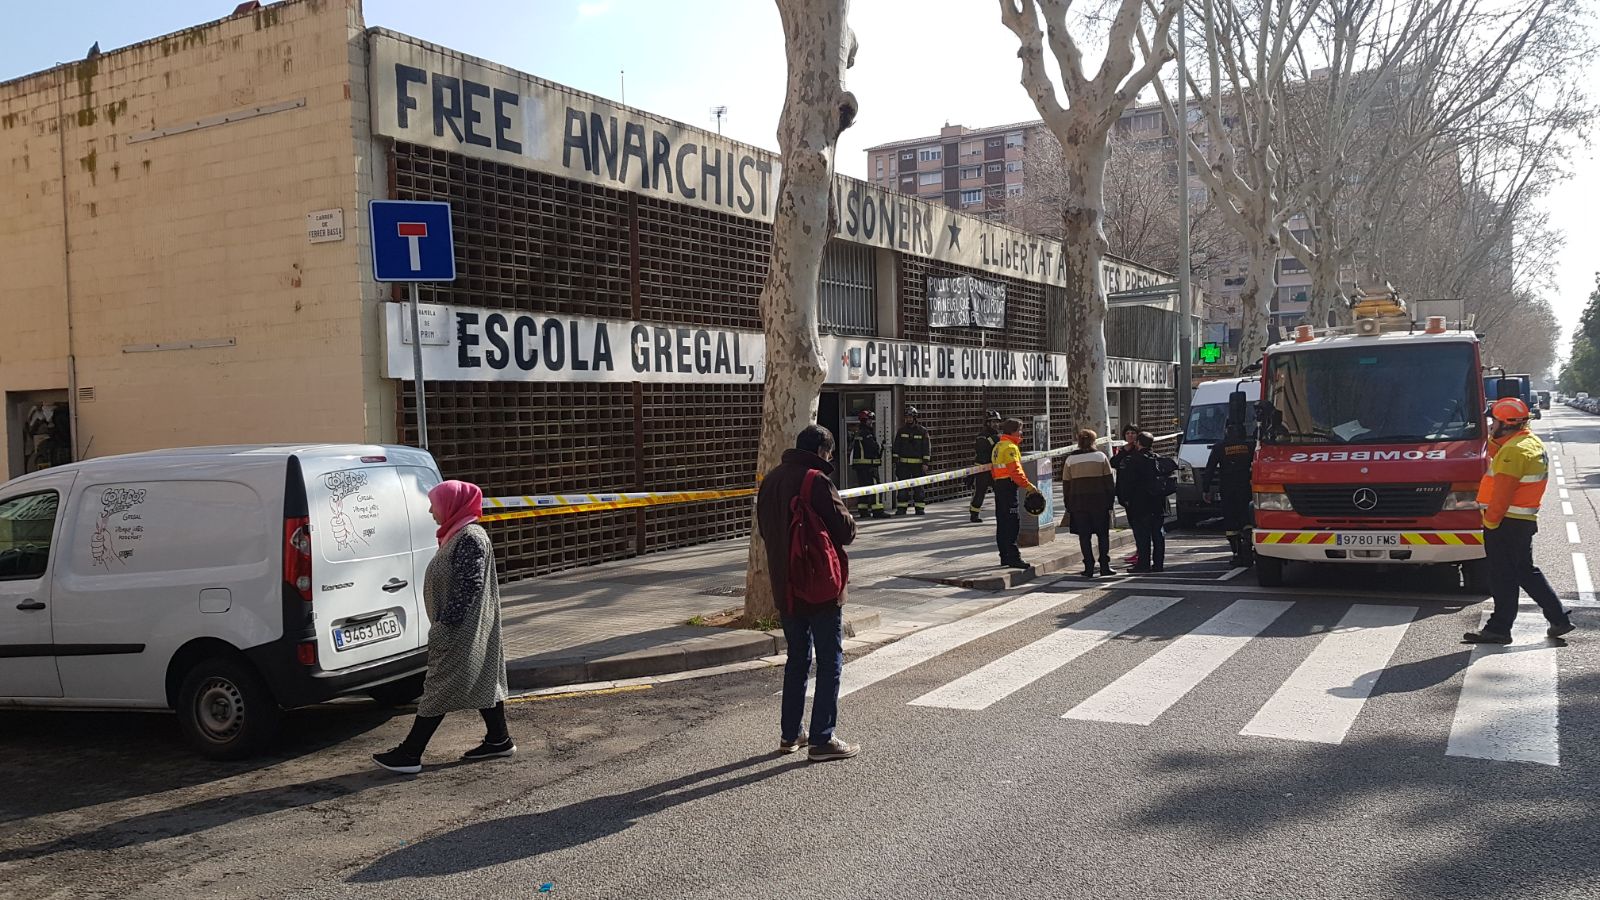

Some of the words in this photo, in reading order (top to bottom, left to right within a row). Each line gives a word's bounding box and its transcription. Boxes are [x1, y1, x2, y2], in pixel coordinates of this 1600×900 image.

[395, 62, 523, 155] FREE
[562, 106, 772, 217] ANARCHIST
[456, 312, 614, 372] ESCOLA
[631, 325, 754, 381] GREGAL,
[866, 341, 930, 378] CENTRE
[937, 347, 955, 379] DE
[962, 349, 1017, 380] CULTURA
[1022, 352, 1060, 382] SOCIAL
[1108, 360, 1135, 384] SOCIAL
[1344, 535, 1373, 545] 9780
[1377, 535, 1397, 545] FMS
[344, 625, 373, 643] 9463
[376, 620, 397, 635] HCB
